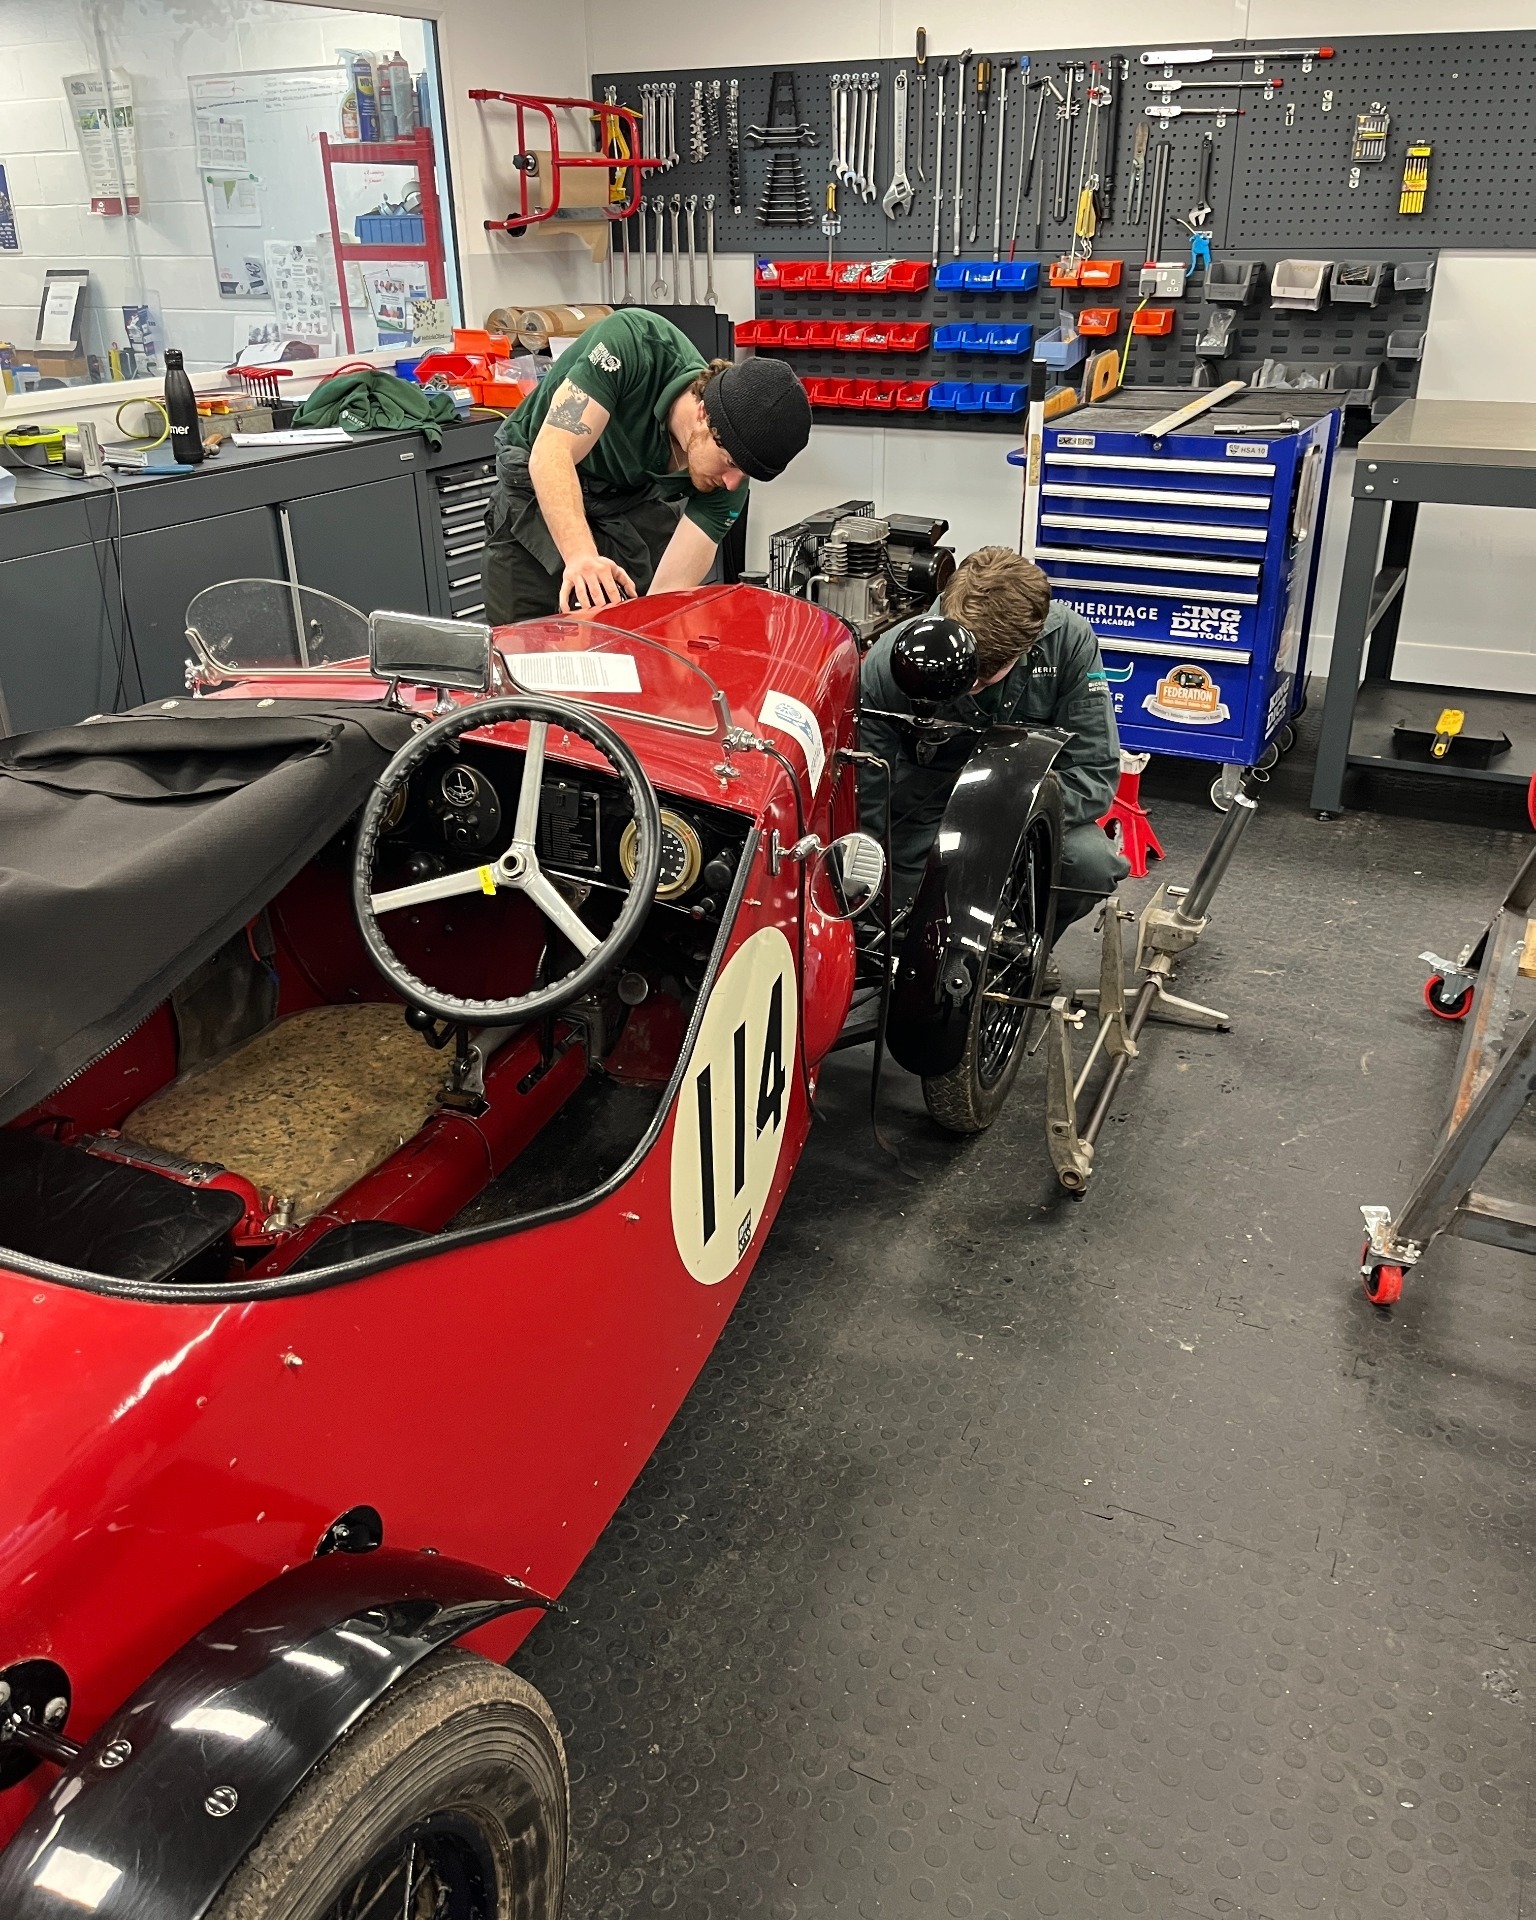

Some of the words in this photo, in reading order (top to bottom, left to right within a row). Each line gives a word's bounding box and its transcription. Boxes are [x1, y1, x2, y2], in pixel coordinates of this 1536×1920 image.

[1074, 601, 1159, 620] HERITAGE
[1170, 616, 1240, 635] DICK
[1198, 631, 1239, 643] TOOLS
[1163, 686, 1213, 702] FEDERATION
[697, 972, 786, 1247] 114
